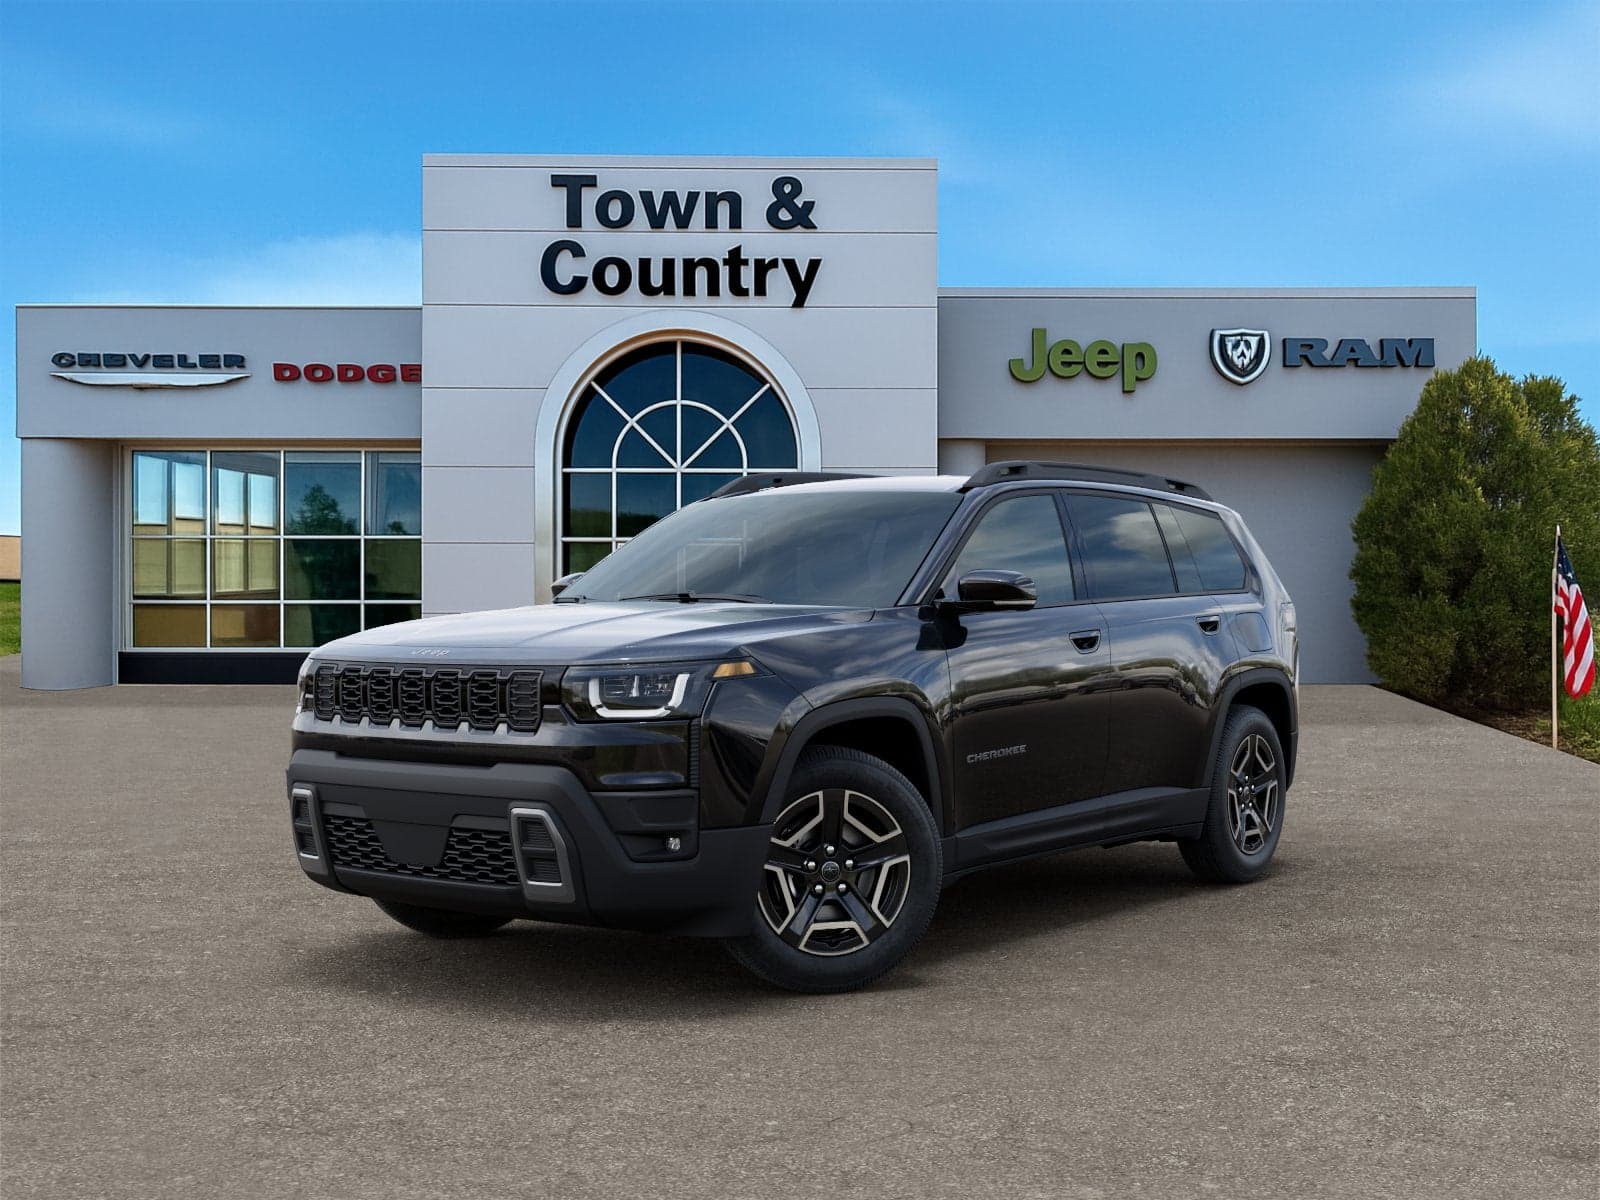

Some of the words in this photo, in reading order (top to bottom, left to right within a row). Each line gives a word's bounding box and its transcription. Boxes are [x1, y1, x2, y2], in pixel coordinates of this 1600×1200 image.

[550, 174, 743, 230] Town
[765, 176, 818, 230] &
[540, 239, 822, 308] Country
[272, 363, 422, 383] DODGE
[1008, 327, 1158, 393] Jeep
[1282, 337, 1436, 368] RAM
[966, 744, 1027, 763] CHEROKEE
